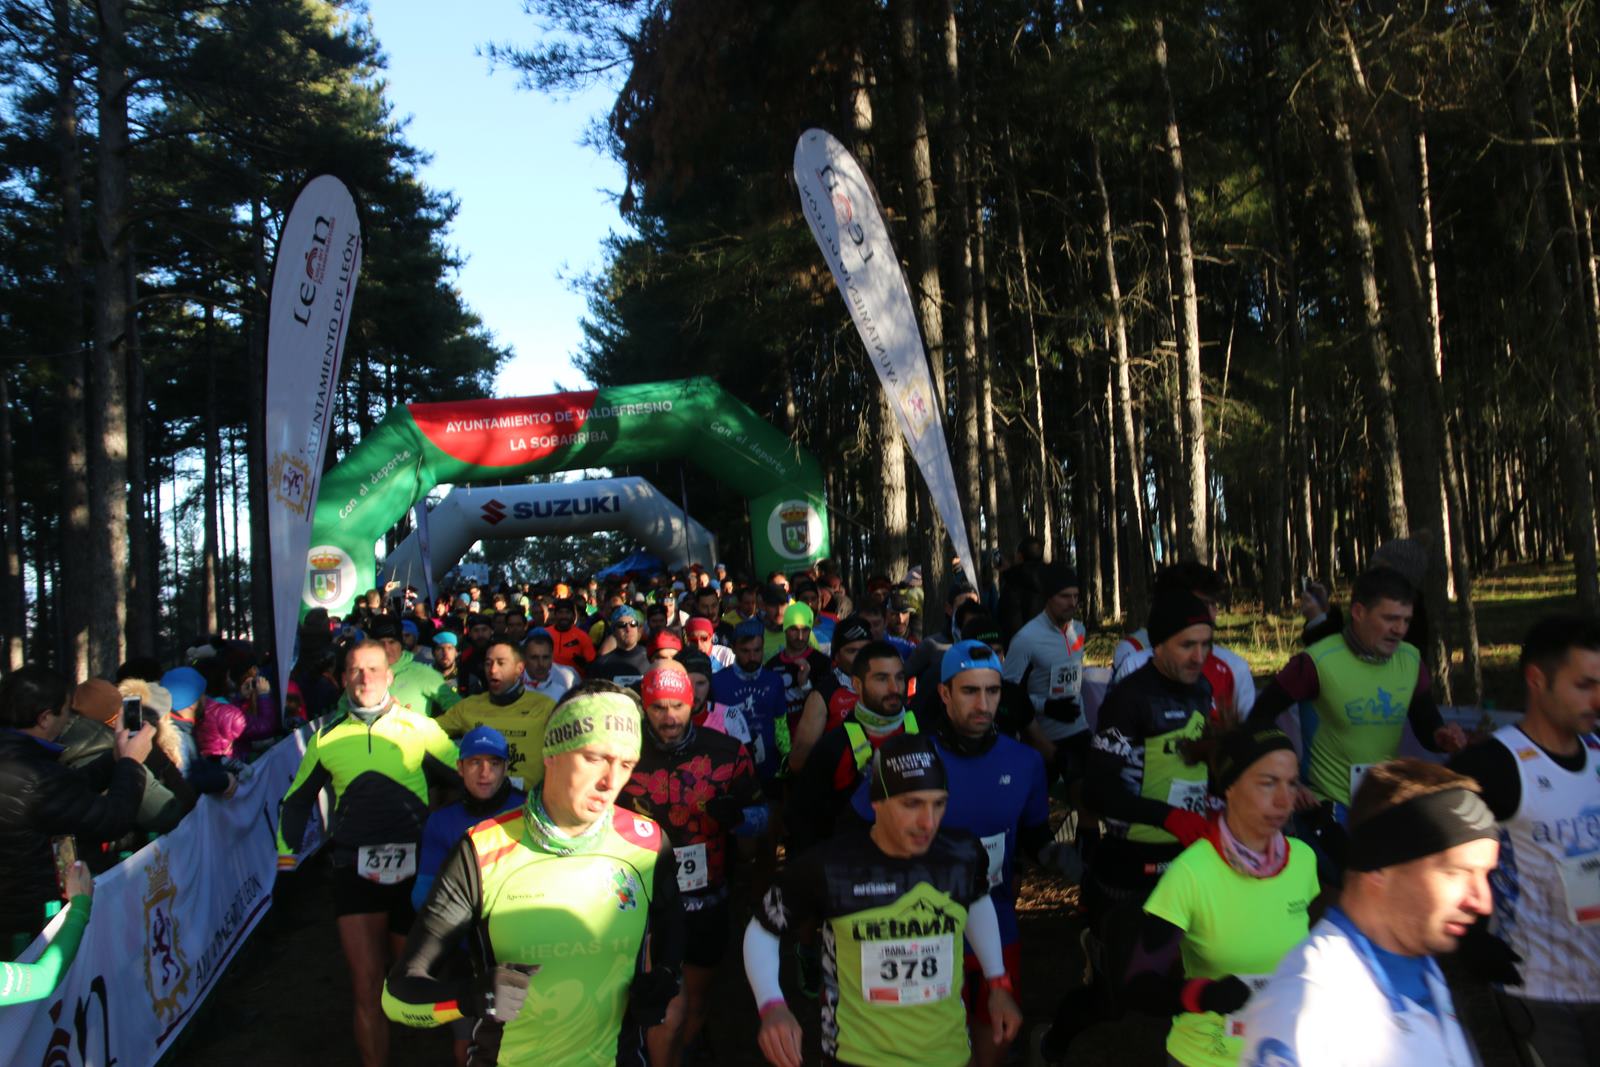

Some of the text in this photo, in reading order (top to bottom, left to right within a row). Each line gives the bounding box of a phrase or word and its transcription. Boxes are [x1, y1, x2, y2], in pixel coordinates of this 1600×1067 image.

[293, 215, 331, 329] León
[307, 232, 357, 459] AYUNTAMIENTO DE LEÓN
[445, 400, 673, 433] AYUNTAMIENTO DE VALDEFRESNO
[510, 430, 609, 452] LA SOBARRIBA
[710, 421, 786, 475] Con el deporte
[338, 450, 412, 519] Con el deporte
[513, 495, 621, 521] SUZUKI
[880, 956, 938, 980] 378
